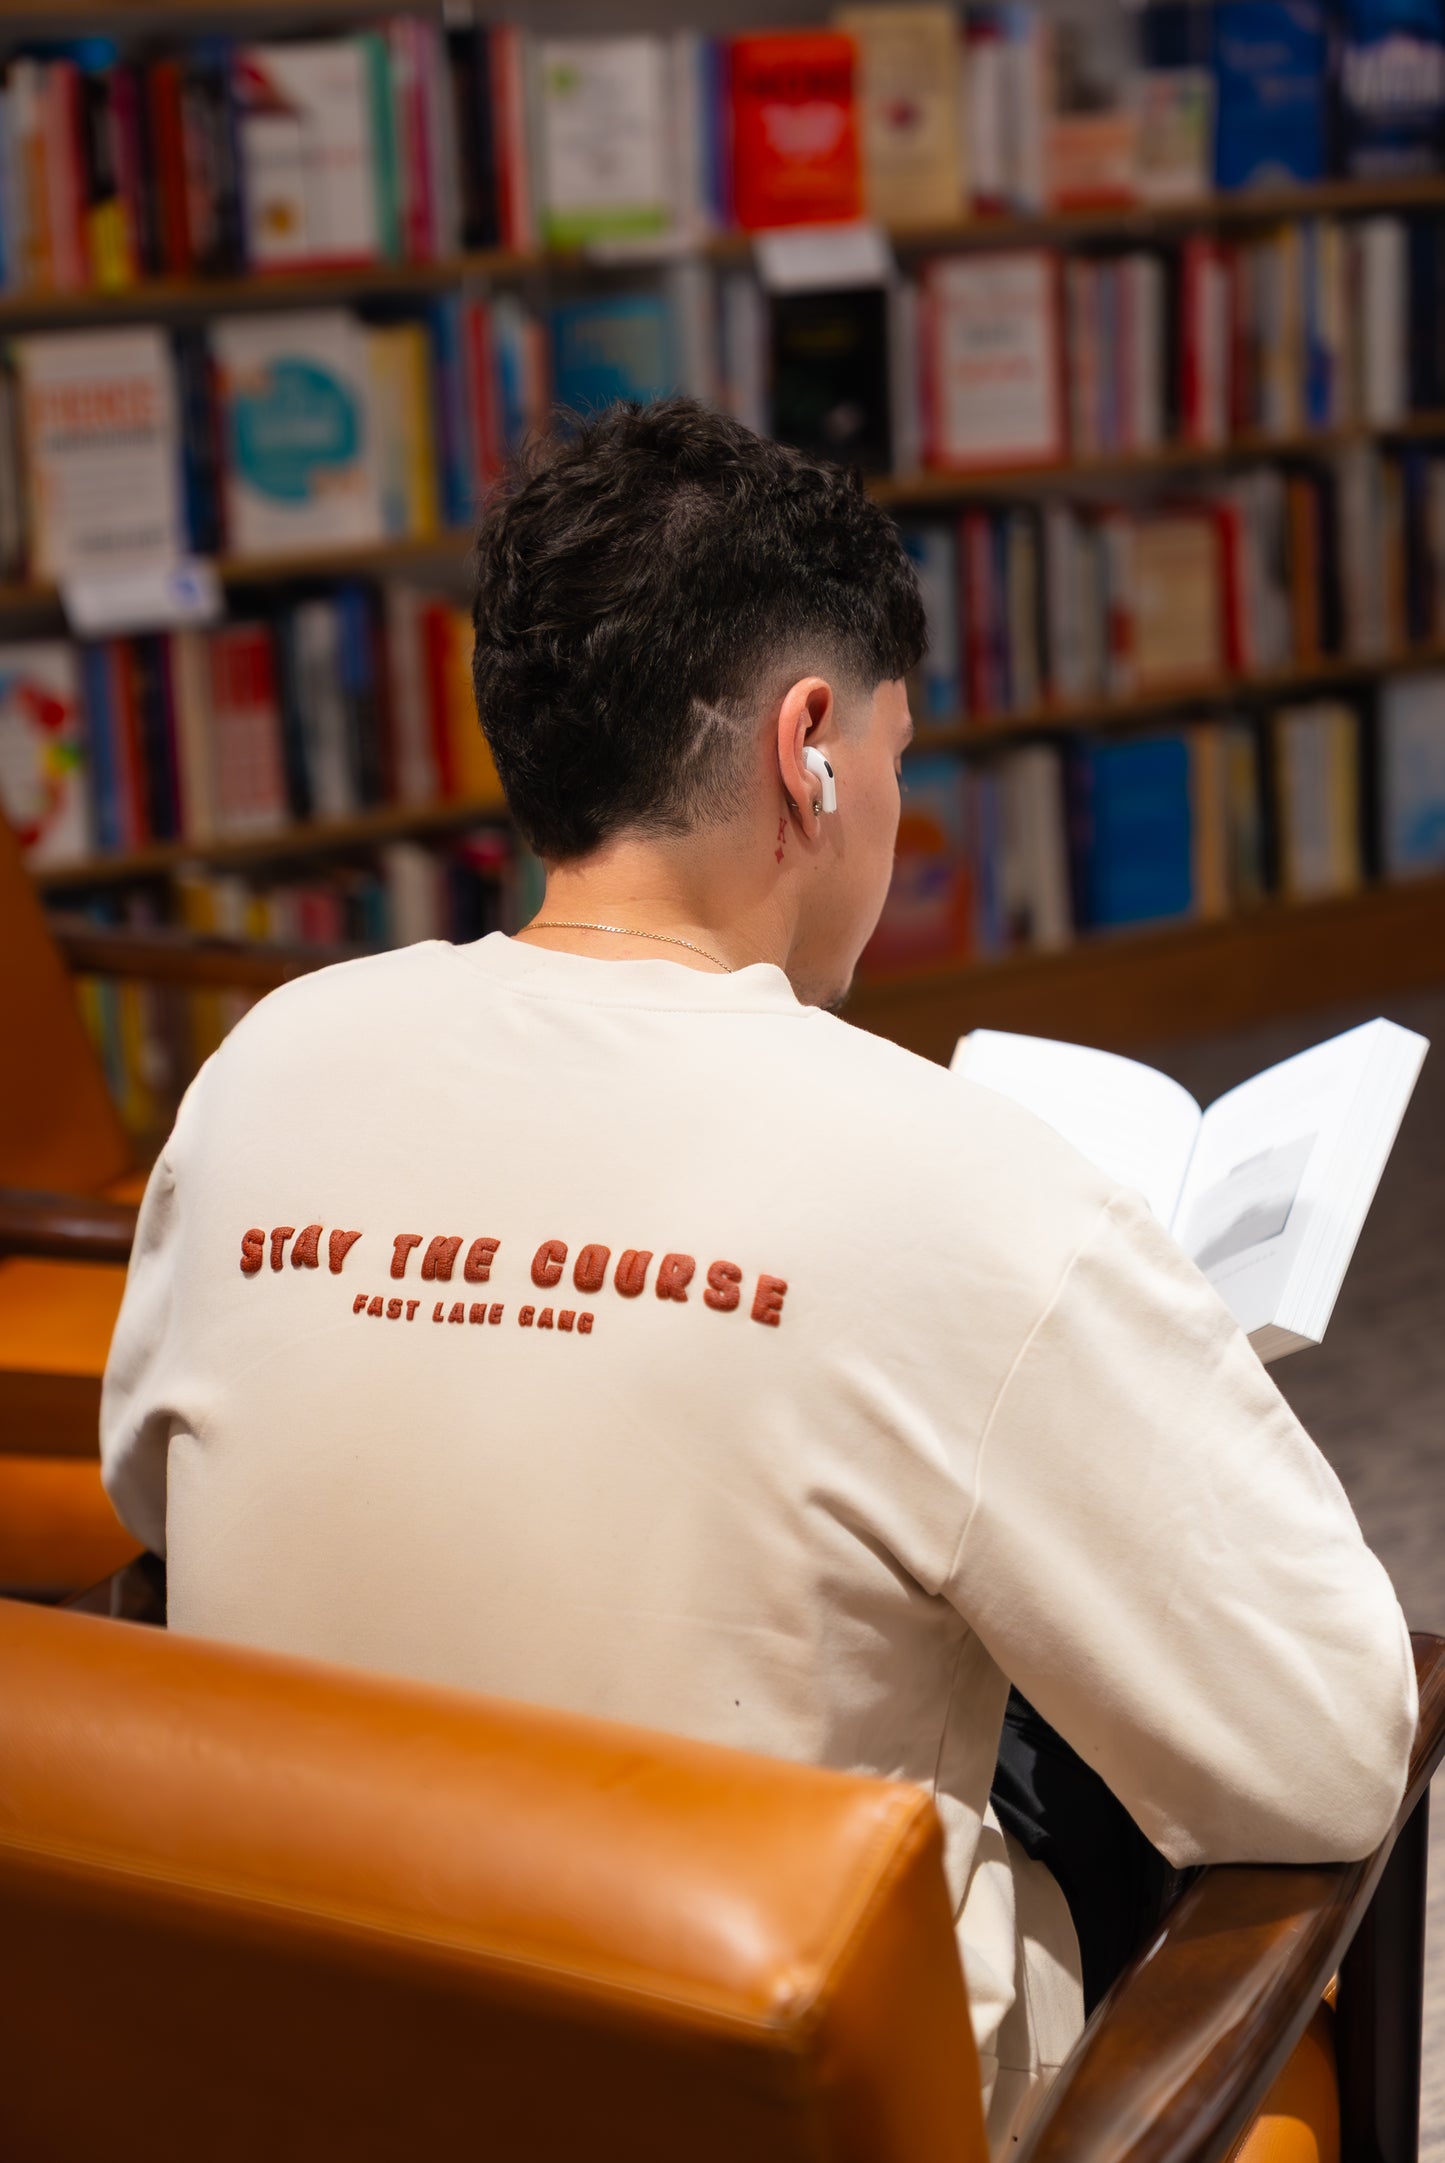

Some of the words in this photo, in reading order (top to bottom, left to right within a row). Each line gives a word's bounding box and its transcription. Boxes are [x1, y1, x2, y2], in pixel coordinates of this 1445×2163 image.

[239, 1223, 363, 1275] STAY
[389, 1233, 503, 1283] THE
[530, 1239, 790, 1328] COURSE
[353, 1294, 420, 1321] FAST
[432, 1302, 505, 1325] LANE
[518, 1305, 595, 1334] GANG
